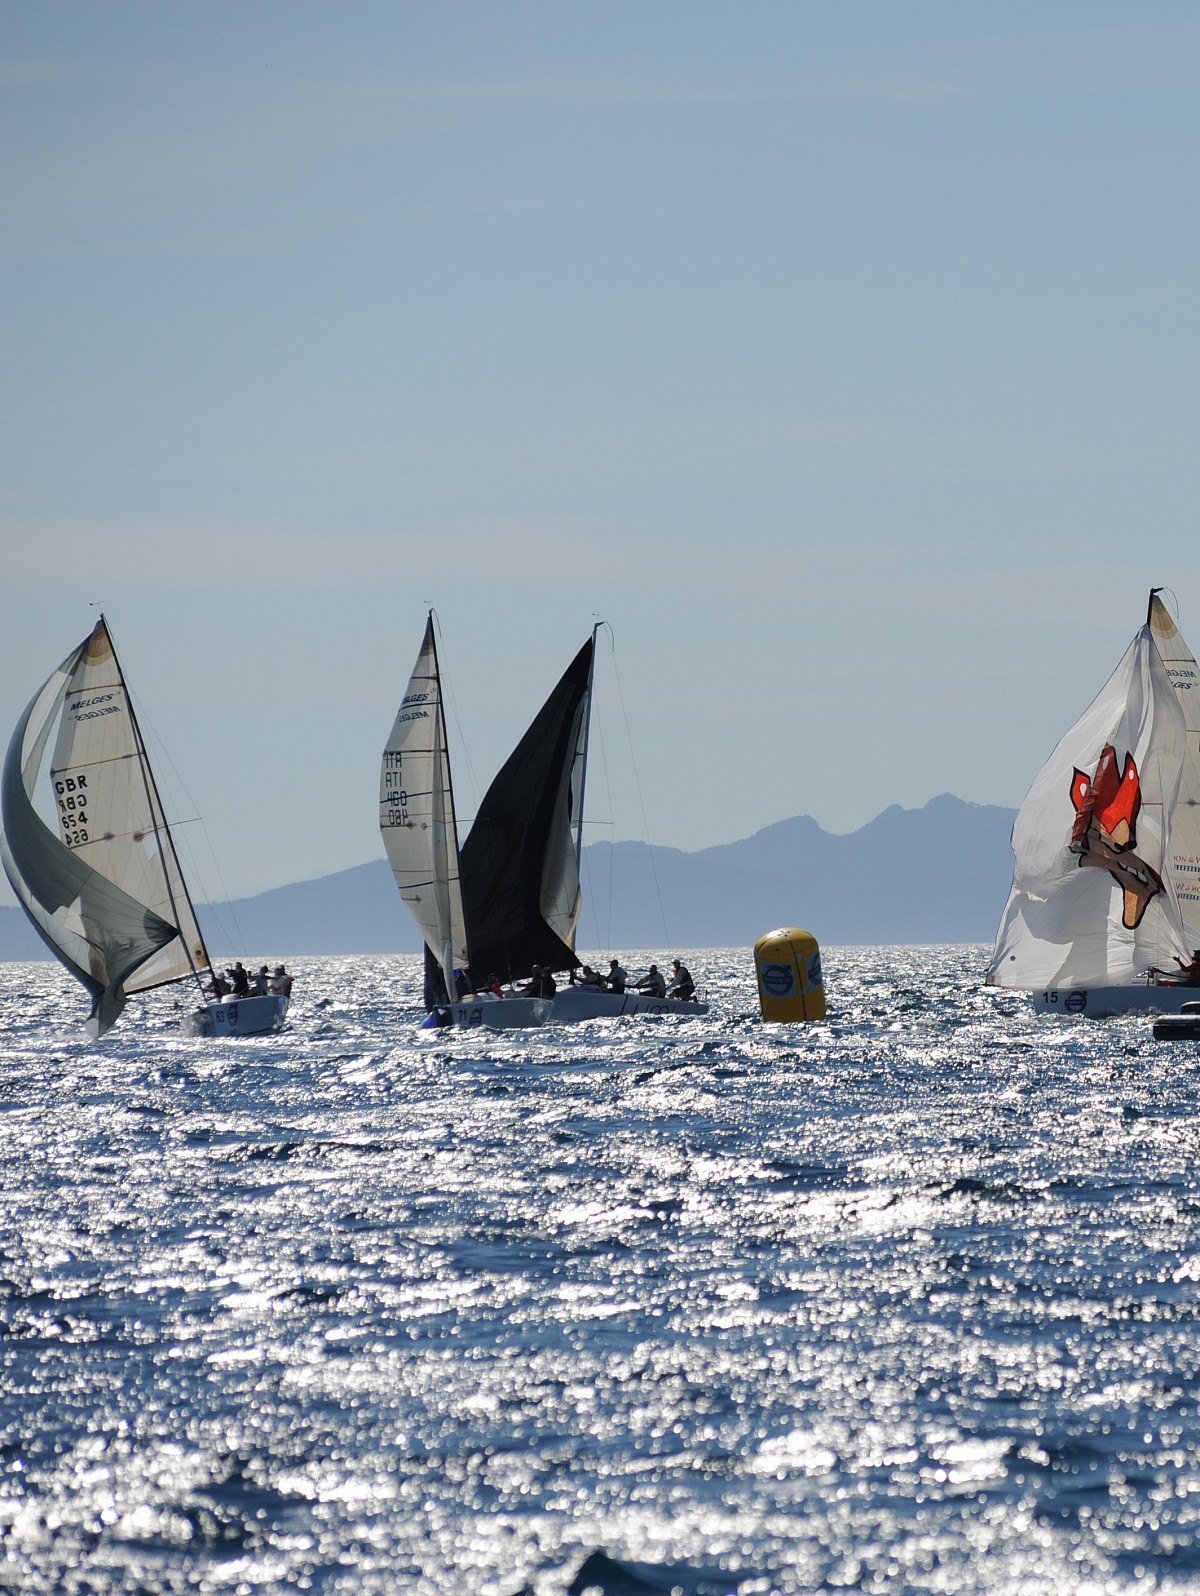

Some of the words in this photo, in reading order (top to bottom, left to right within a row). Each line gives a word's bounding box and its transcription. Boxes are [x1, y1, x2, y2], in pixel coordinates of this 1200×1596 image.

[70, 693, 114, 711] MELGES
[386, 752, 402, 768] ITA
[55, 775, 88, 795] GBR
[61, 811, 88, 829] 654
[1042, 991, 1058, 1003] 15
[458, 1008, 467, 1022] 71
